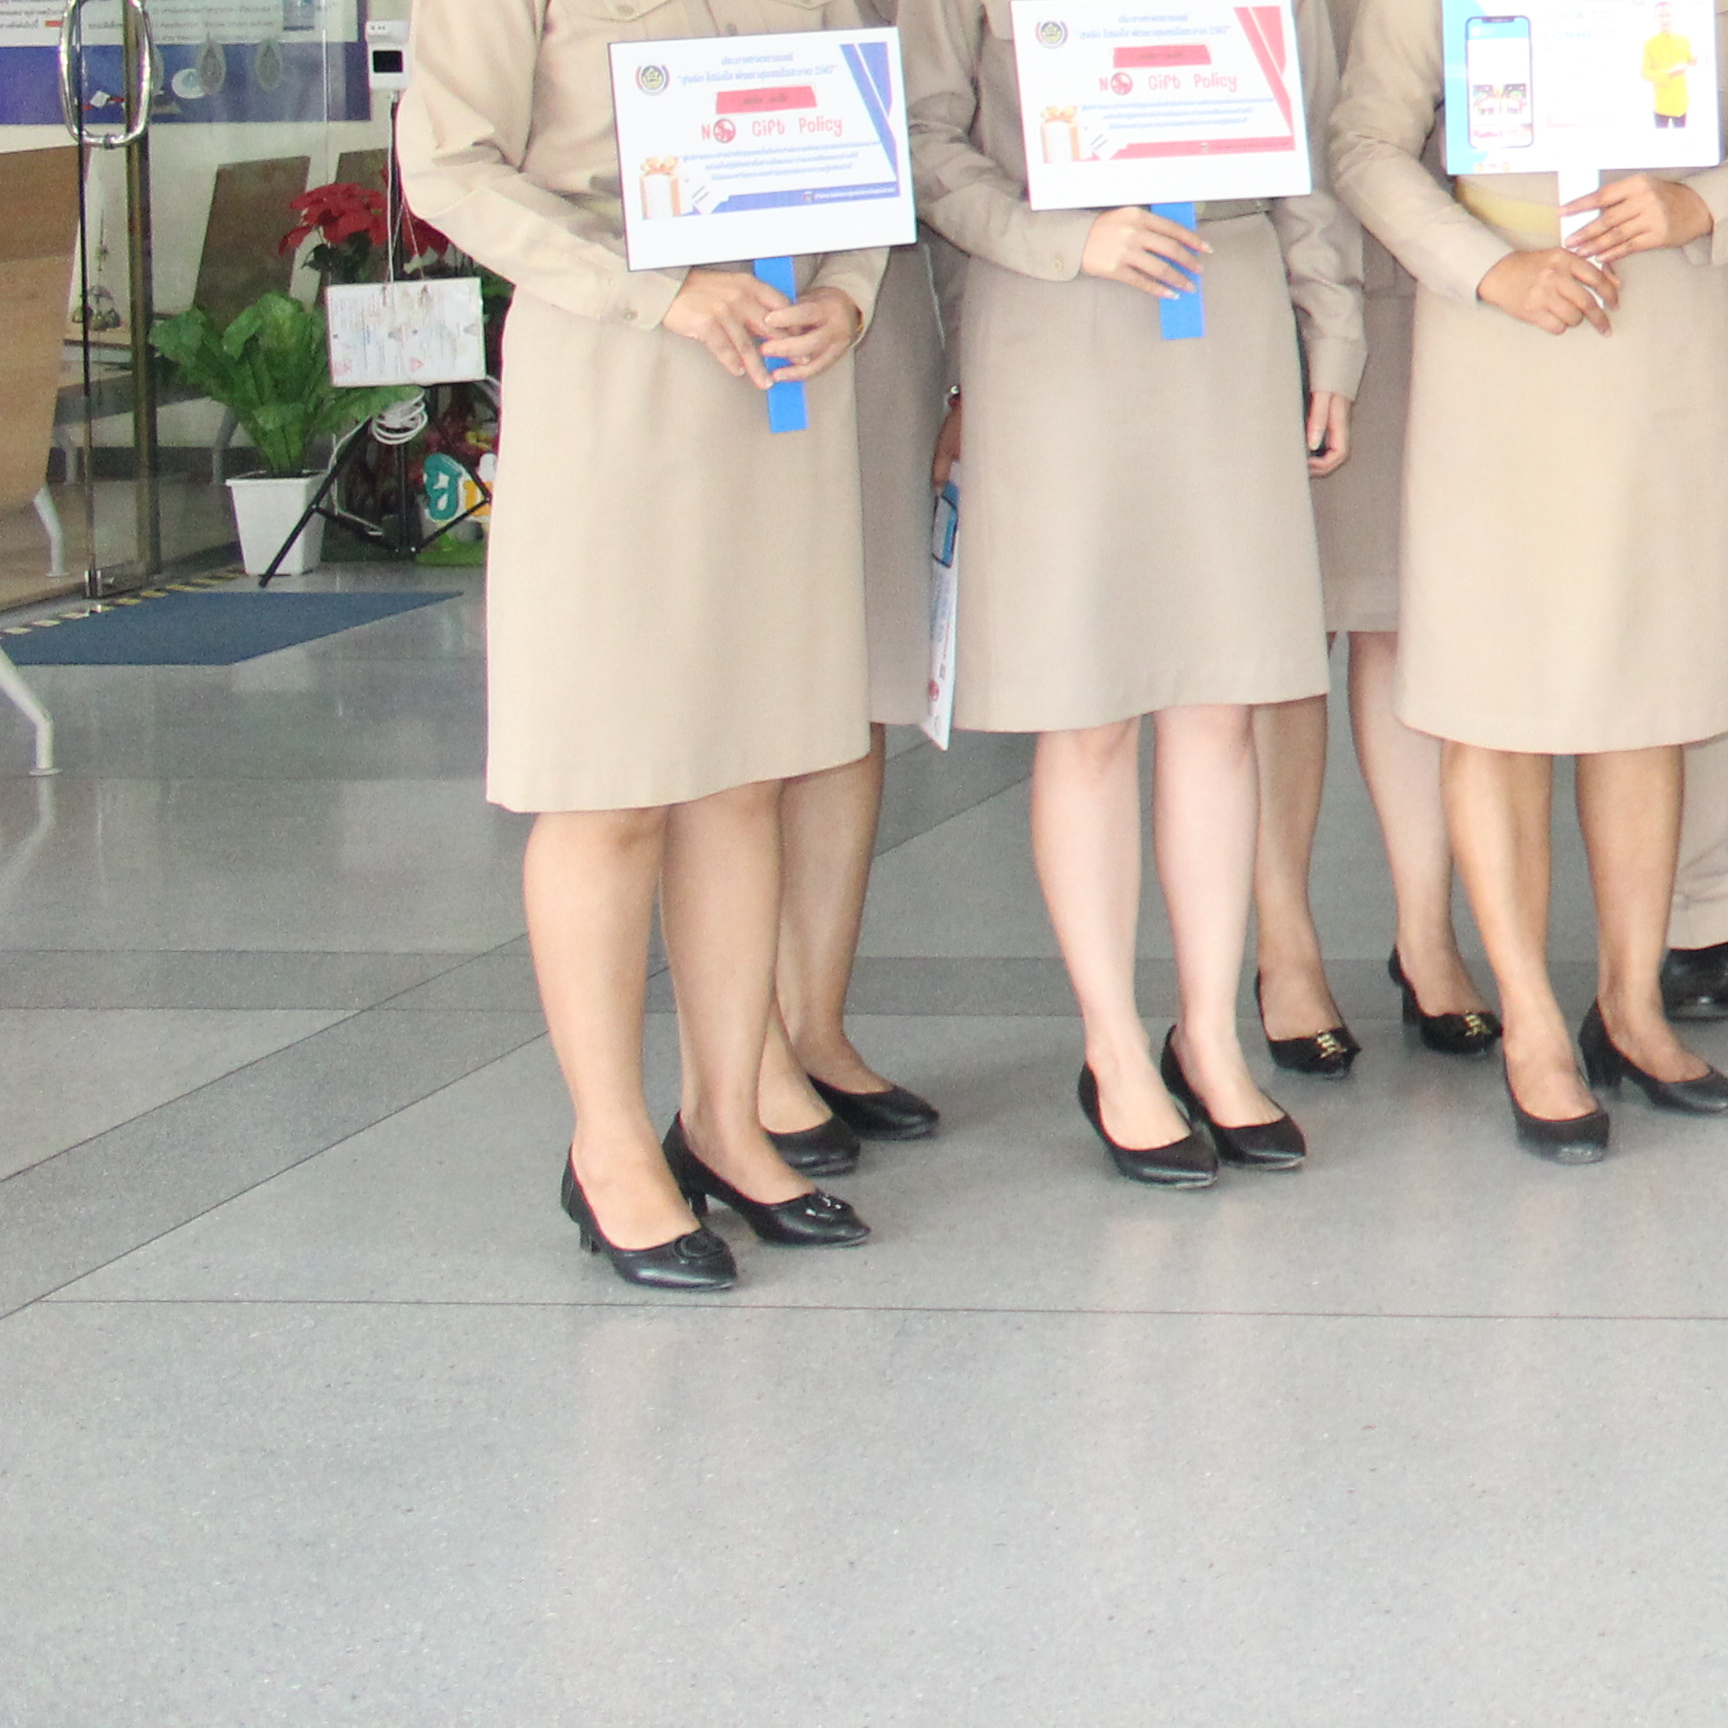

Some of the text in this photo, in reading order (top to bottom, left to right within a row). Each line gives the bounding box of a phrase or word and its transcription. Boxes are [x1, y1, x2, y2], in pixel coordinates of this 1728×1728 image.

[1148, 73, 1181, 91] Gift
[1194, 71, 1238, 94] Policy
[751, 118, 786, 139] Gift
[798, 116, 844, 145] Policy
